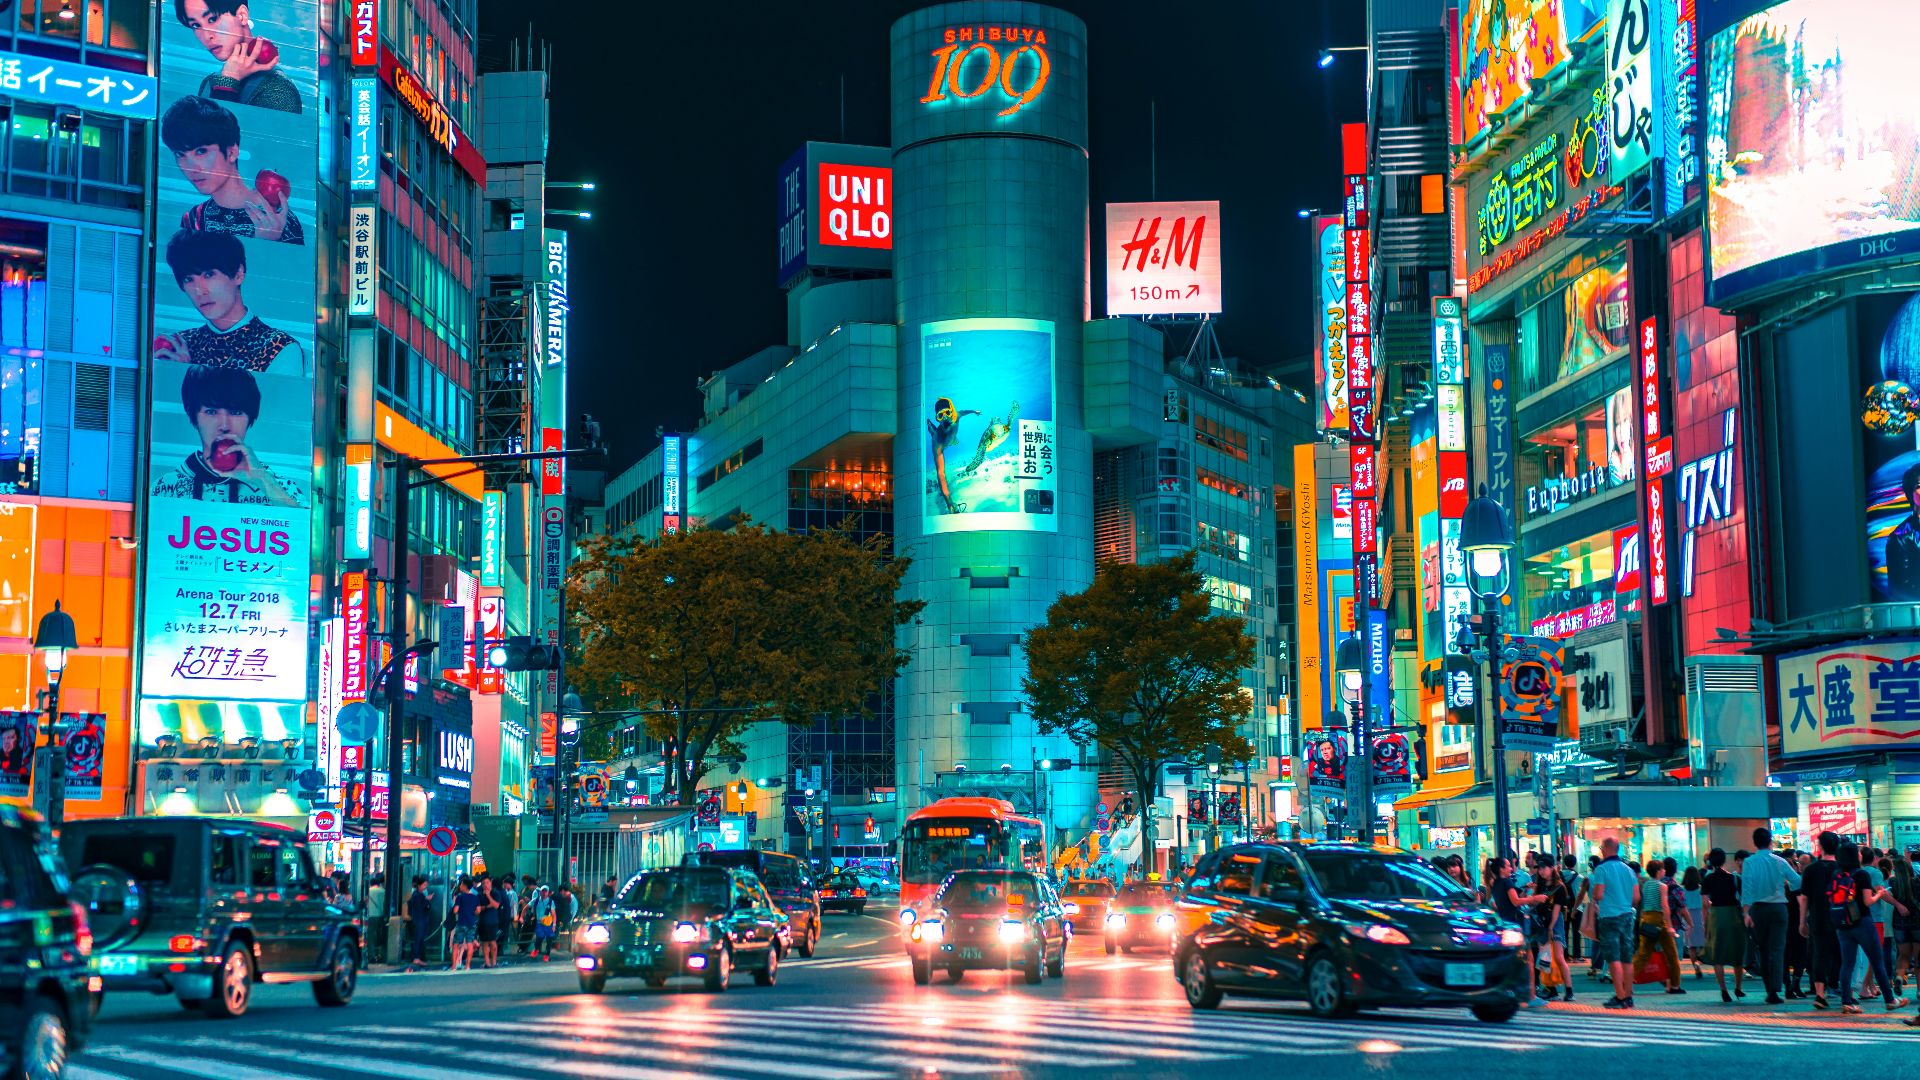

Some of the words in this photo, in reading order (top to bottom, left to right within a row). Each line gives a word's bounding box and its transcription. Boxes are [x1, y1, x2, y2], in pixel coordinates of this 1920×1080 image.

[356, 2, 374, 54] ガスト
[943, 26, 1047, 45] SHIBUYA
[919, 41, 1050, 117] 109
[357, 90, 371, 178] 英会話イーオン
[429, 101, 457, 155] ガスト
[785, 166, 800, 218] THE
[828, 174, 885, 206] UNI
[1511, 155, 1557, 233] 西村
[779, 208, 805, 270] PRIME
[829, 208, 890, 241] QLO
[1121, 216, 1206, 273] H&M
[355, 213, 369, 307] 渋谷駅前ビル
[549, 241, 563, 275] BIC
[1860, 237, 1896, 257] DHC
[549, 278, 570, 365] CAMERA
[1355, 391, 1366, 399] 6F
[1023, 431, 1053, 444] 世界に
[1489, 394, 1511, 517] サマーフルー
[1442, 477, 1465, 493] JTB
[1528, 461, 1605, 514] Euphoria
[168, 516, 290, 555] Jesus
[240, 517, 259, 525] NEW
[261, 519, 289, 527] SINGLE
[176, 588, 213, 600] Arena
[219, 590, 245, 601] Tour
[249, 592, 279, 603] 2018
[199, 603, 238, 619] 12.7
[241, 611, 260, 620] FRI
[164, 621, 288, 637] さいたまスーパーアリーナ
[450, 611, 461, 665] 渋谷駅前
[1448, 606, 1458, 640] フルーツ
[1371, 623, 1383, 675] MIZUHO
[1453, 671, 1474, 707] HUB
[1789, 660, 1920, 735] 大盛堂
[1514, 724, 1528, 732] Tik
[1530, 725, 1543, 734] Tok
[440, 731, 473, 774] LUSH
